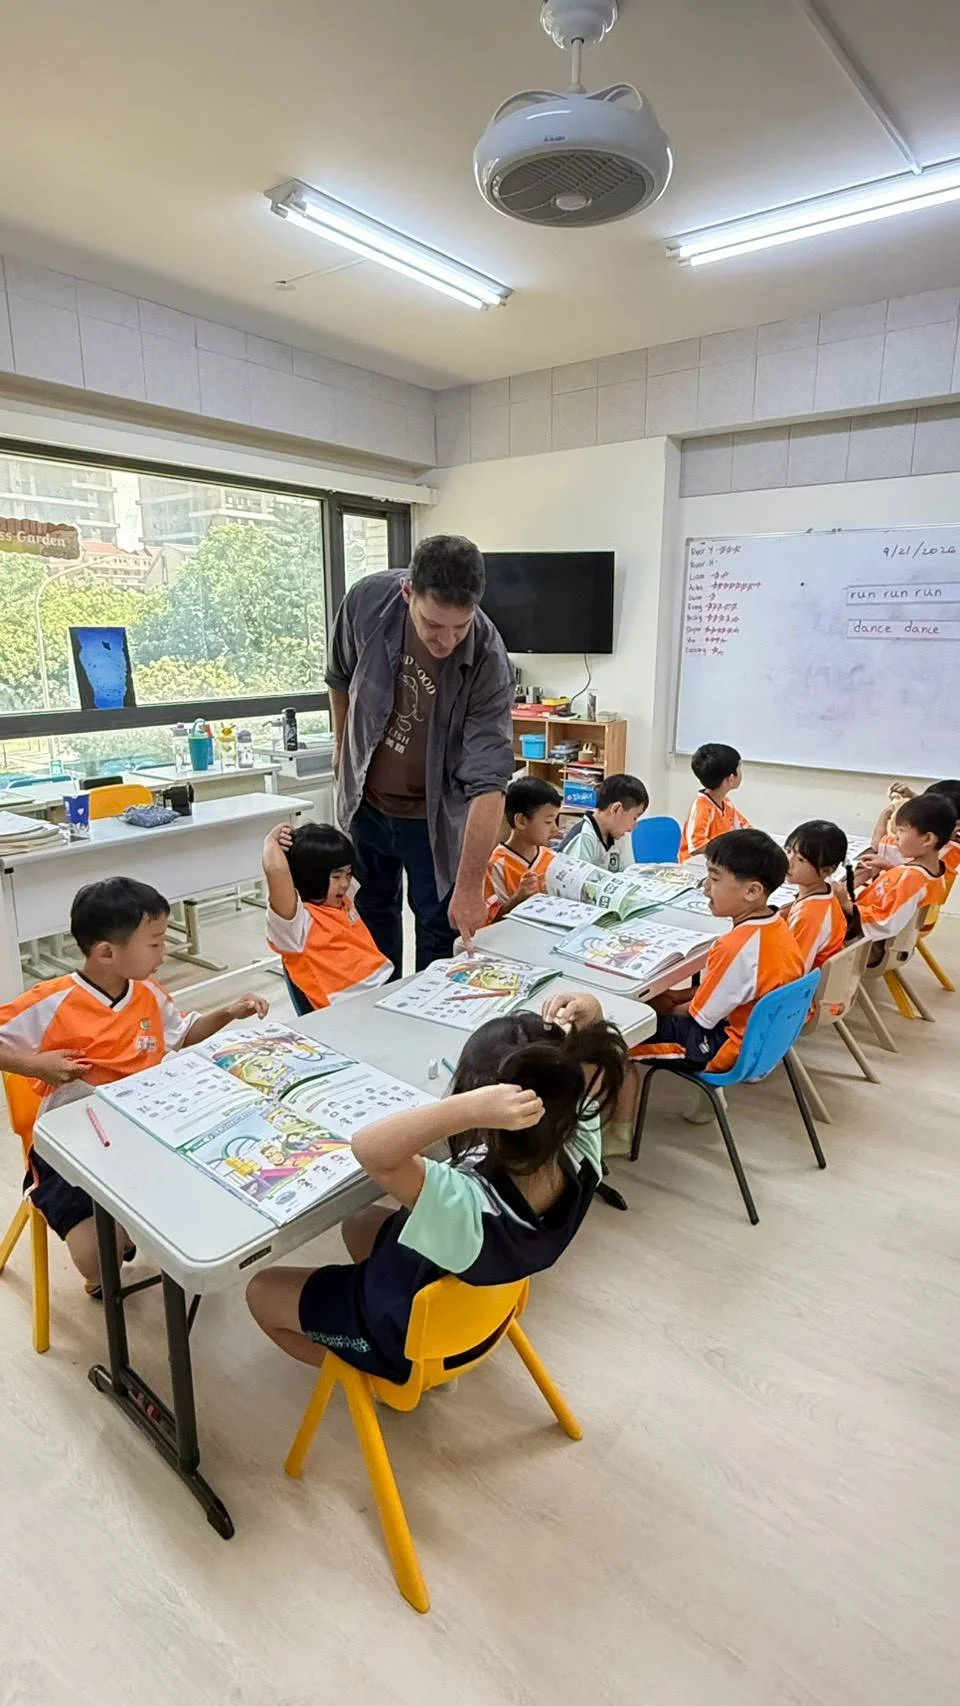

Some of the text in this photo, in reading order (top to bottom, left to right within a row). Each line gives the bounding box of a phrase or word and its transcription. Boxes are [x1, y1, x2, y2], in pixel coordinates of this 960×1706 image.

[17, 531, 66, 548] Garden
[883, 541, 957, 559] 9/21/2026
[850, 588, 942, 599] run run run
[853, 619, 941, 634] dance dance
